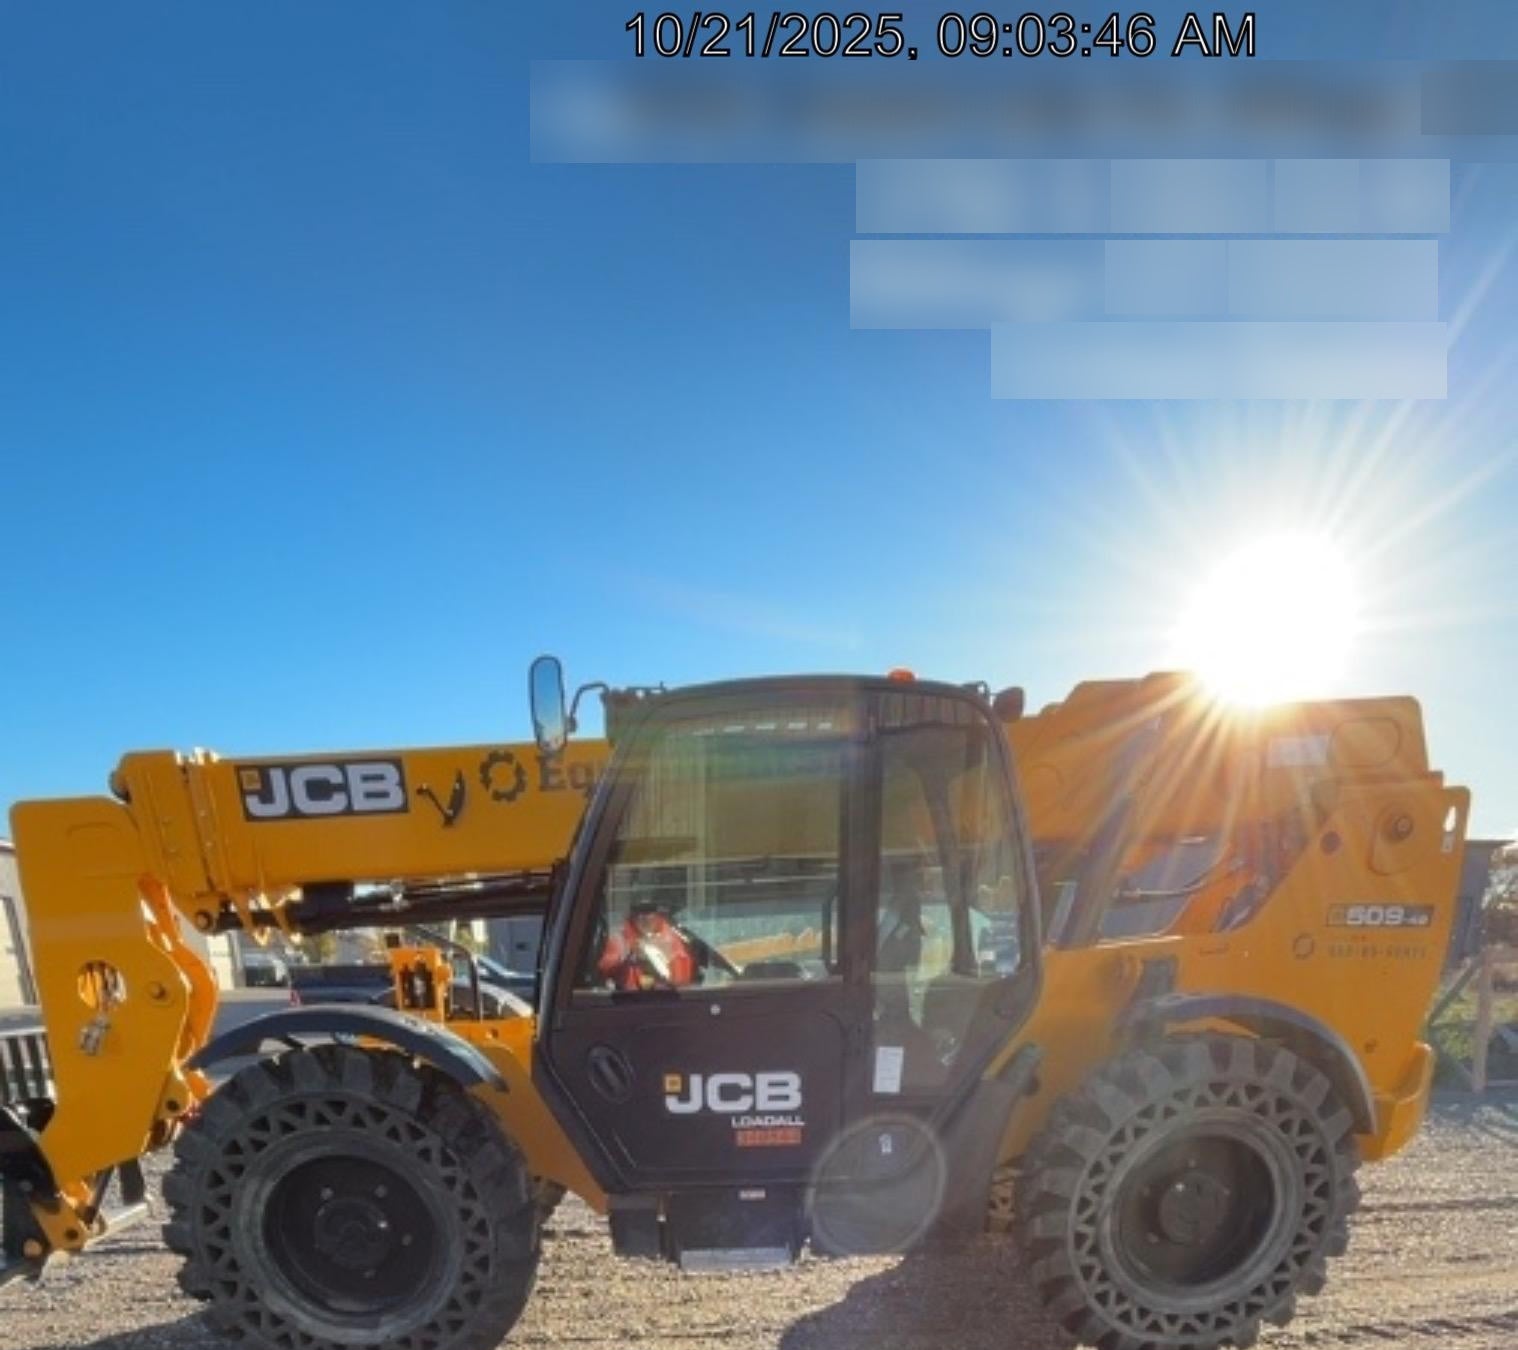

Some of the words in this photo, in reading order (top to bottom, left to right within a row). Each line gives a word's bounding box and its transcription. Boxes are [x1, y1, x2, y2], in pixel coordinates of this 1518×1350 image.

[243, 760, 405, 818] JCB
[664, 1071, 803, 1114] JCB
[731, 1115, 805, 1128] LOADALL
